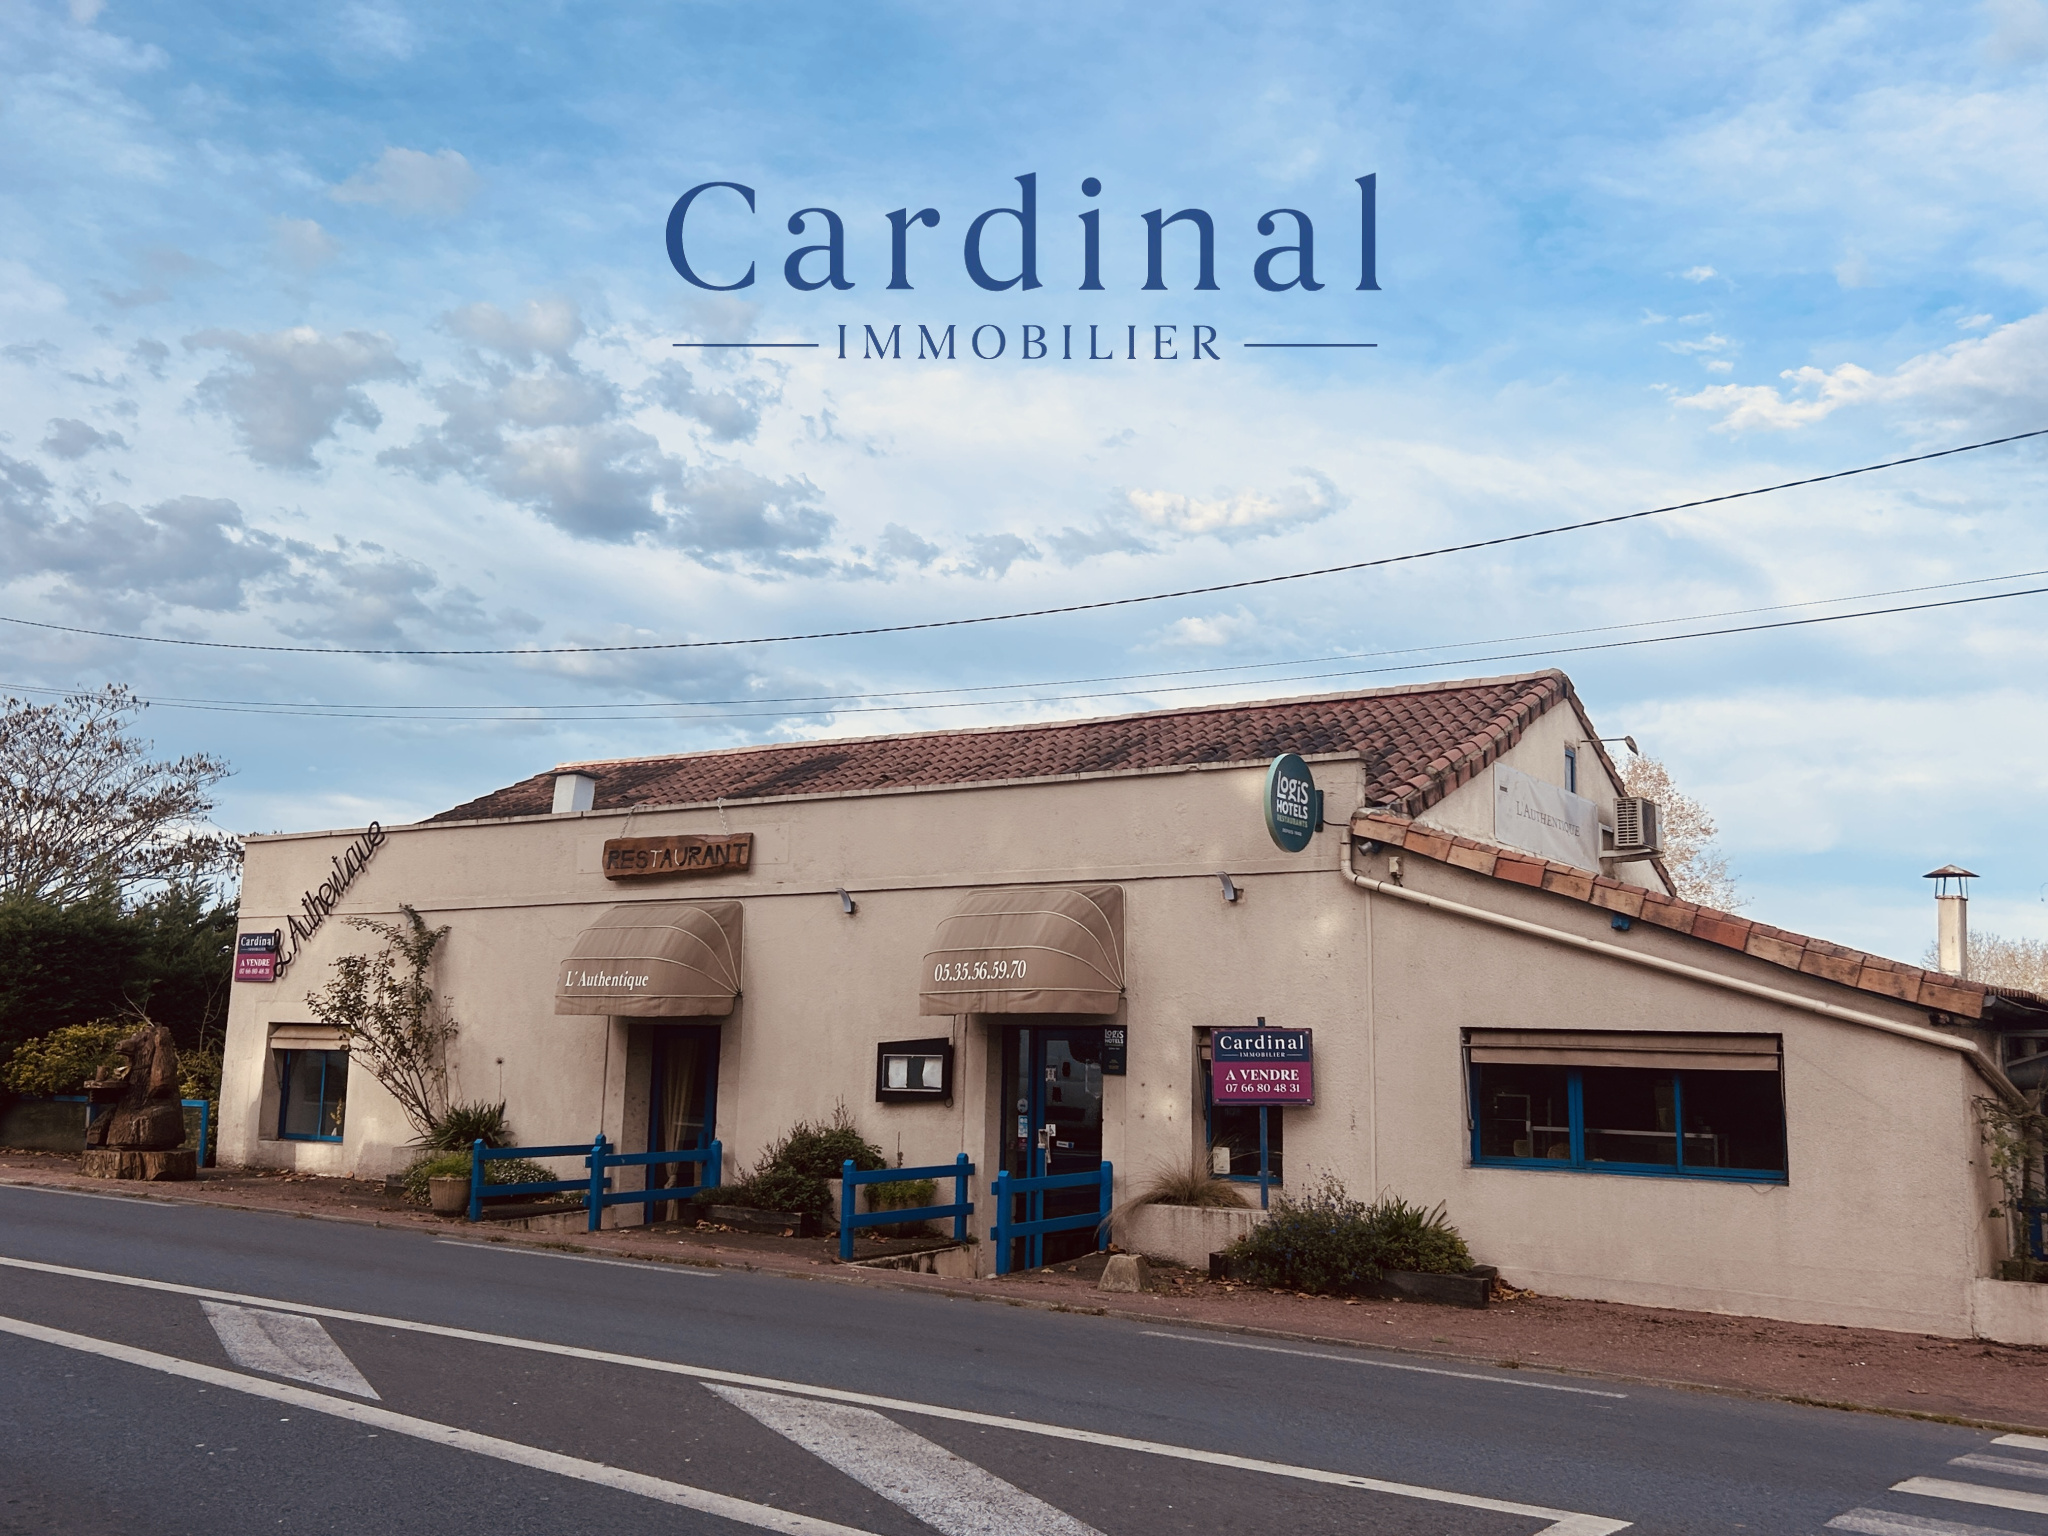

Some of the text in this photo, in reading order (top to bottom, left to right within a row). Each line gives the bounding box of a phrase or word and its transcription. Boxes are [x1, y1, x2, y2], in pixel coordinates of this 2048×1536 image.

[1276, 799, 1309, 820] HOTELS
[1276, 813, 1309, 829] RESTAURANTS
[1516, 800, 1581, 837] L'AUTHENTIQUE
[606, 843, 748, 870] RESTAURANT
[240, 936, 275, 946] Cardinal
[246, 958, 271, 967] VENDRE
[934, 960, 1027, 982] 05.35.56.59.70
[1219, 1034, 1304, 1050] Cardinal
[1225, 1069, 1300, 1081] A VENDRE
[1225, 1083, 1301, 1093] 07 66 80 48 31
